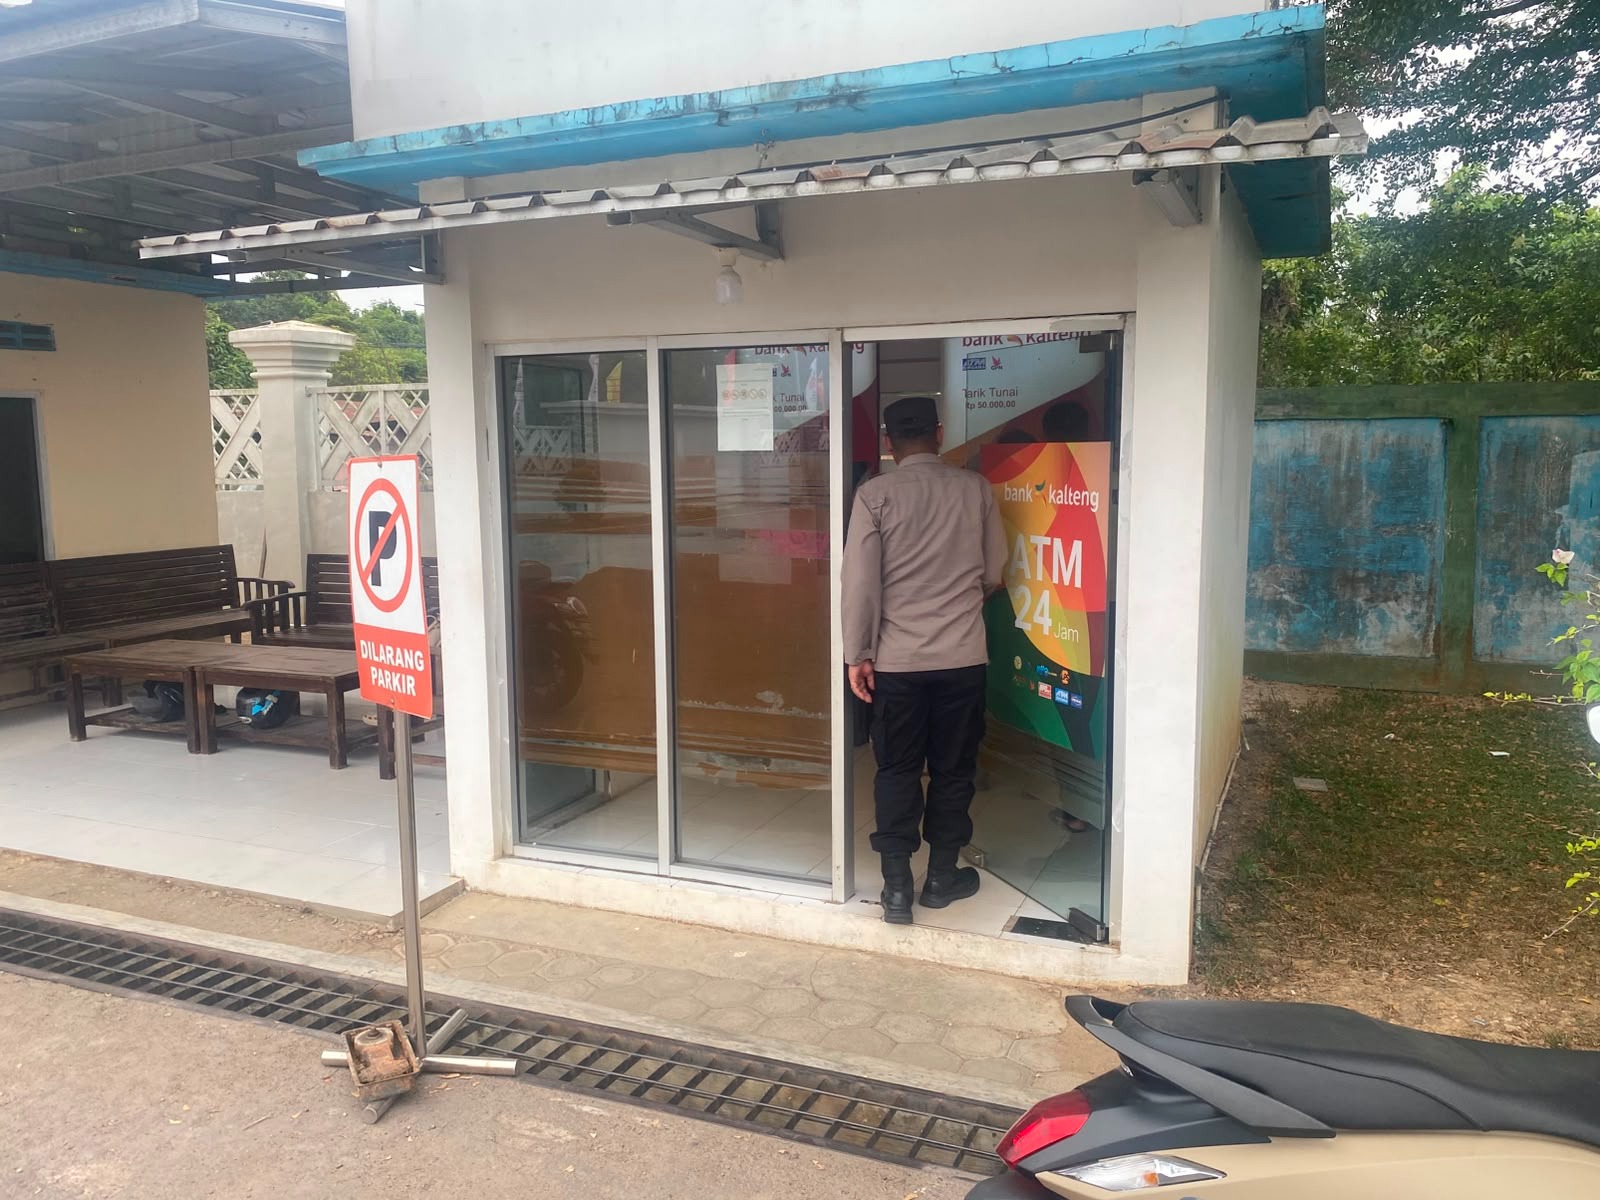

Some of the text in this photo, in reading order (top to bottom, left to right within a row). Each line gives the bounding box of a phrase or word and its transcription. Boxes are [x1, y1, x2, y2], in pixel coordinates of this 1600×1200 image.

[989, 386, 1018, 398] Tunai
[1004, 483, 1100, 513] bank kalteng
[1010, 534, 1083, 589] ATM
[1014, 588, 1080, 644] 24 Jam
[360, 639, 425, 672] DILARANG
[370, 665, 416, 697] PARKIR
